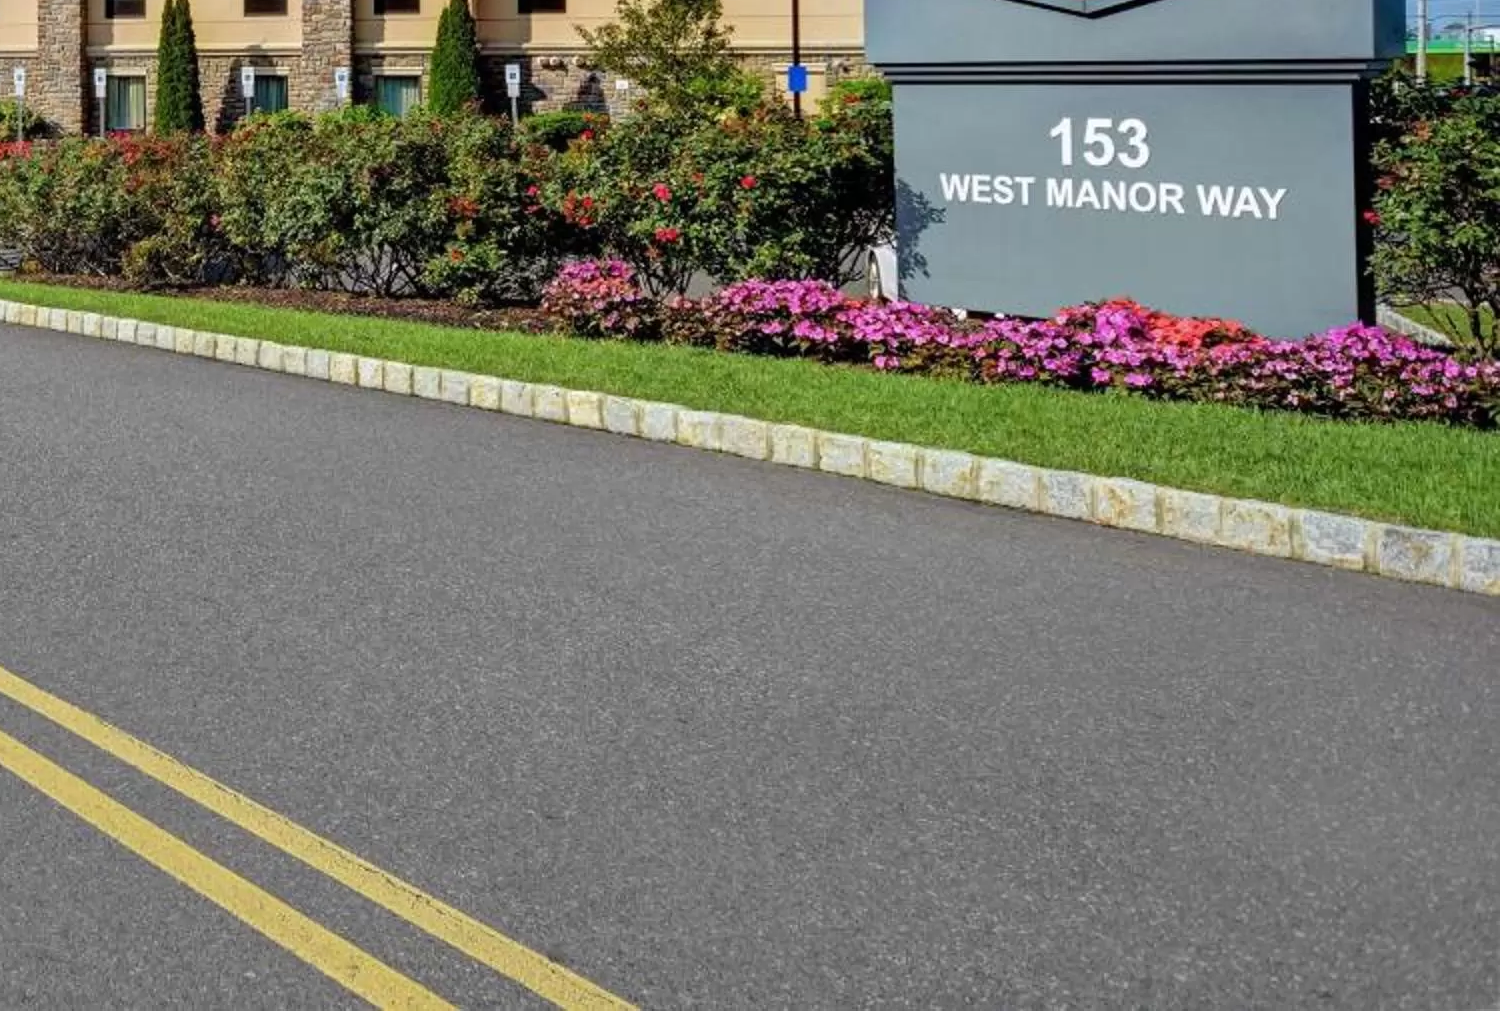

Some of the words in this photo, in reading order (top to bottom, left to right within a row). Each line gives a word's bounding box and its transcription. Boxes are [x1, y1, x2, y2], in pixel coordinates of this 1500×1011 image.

[1050, 117, 1150, 168] 153
[939, 172, 1036, 206] WEST
[1046, 177, 1185, 214] MANOR
[1196, 184, 1287, 220] WAY
